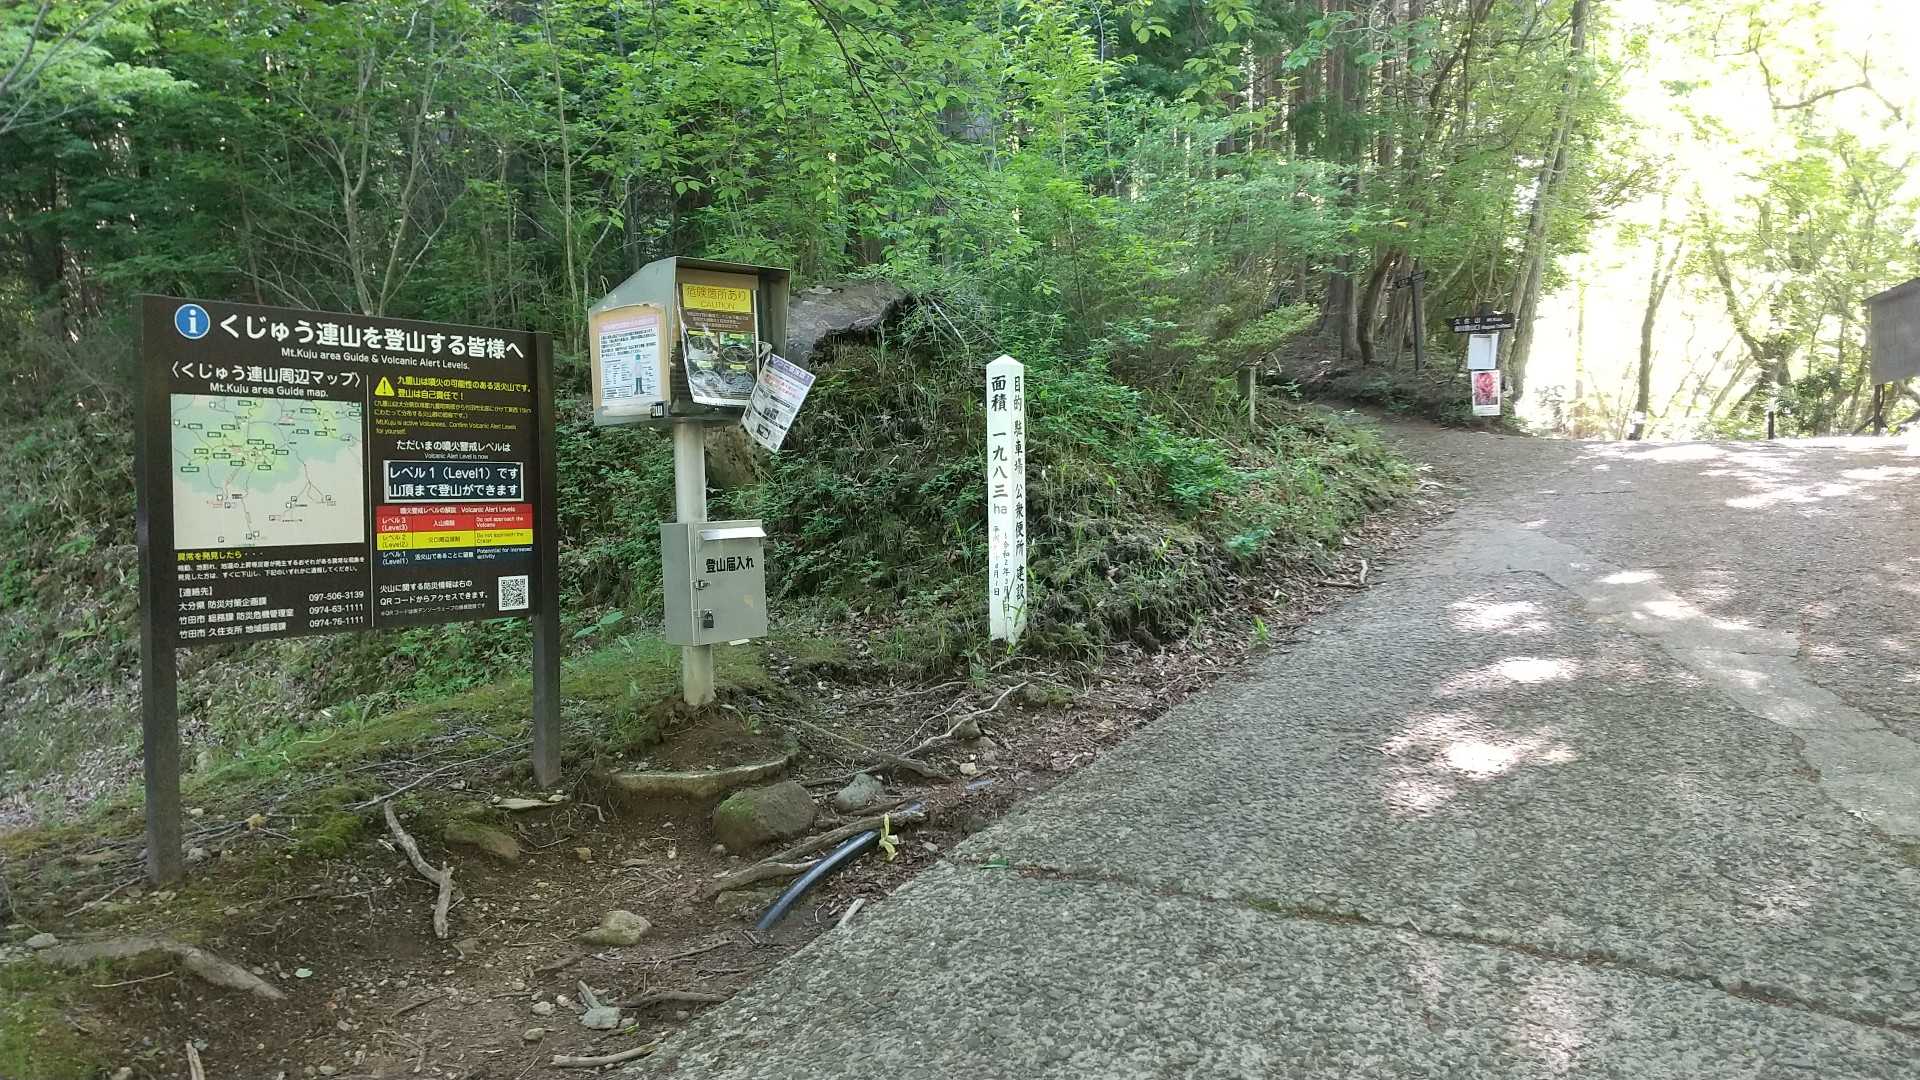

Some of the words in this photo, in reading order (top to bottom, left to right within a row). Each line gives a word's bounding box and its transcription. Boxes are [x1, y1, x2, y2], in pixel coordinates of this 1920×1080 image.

[220, 314, 524, 359] くじゅう連山を登山する皆様へ
[281, 347, 318, 359] Mt.Kuju
[319, 352, 341, 361] area
[343, 353, 369, 363] Guide
[371, 355, 379, 363] &
[381, 355, 418, 367] Volcanic
[419, 359, 441, 368] Alert
[442, 360, 470, 370] Levels.
[209, 382, 250, 394] Mt.Kuju
[251, 385, 274, 395] area
[276, 386, 304, 396] Guide
[306, 389, 329, 398] map.
[991, 375, 1008, 412] 面積
[1013, 375, 1022, 411] 目的
[396, 439, 512, 452] ただいまの噴火警戒レベルは
[389, 483, 518, 497] 山頂まで登山ができます
[460, 506, 483, 514] Volcanic
[499, 505, 516, 513] Levels
[1015, 483, 1025, 557] 公衆便所
[705, 556, 755, 574] 登山届入れ
[380, 580, 473, 593] 火山に関する防災情報は右の
[1016, 564, 1025, 600] 建設
[178, 601, 206, 611] 大分県
[207, 596, 267, 609] 防災対策企画課
[308, 590, 365, 602] 097-506-3139
[179, 615, 206, 625] 竹田市
[208, 612, 235, 623] 総務課
[236, 608, 294, 621] 防災危機管理室
[308, 603, 364, 615] 0974-63-1111
[179, 629, 206, 639] 竹田市
[208, 625, 243, 637] 久住支所
